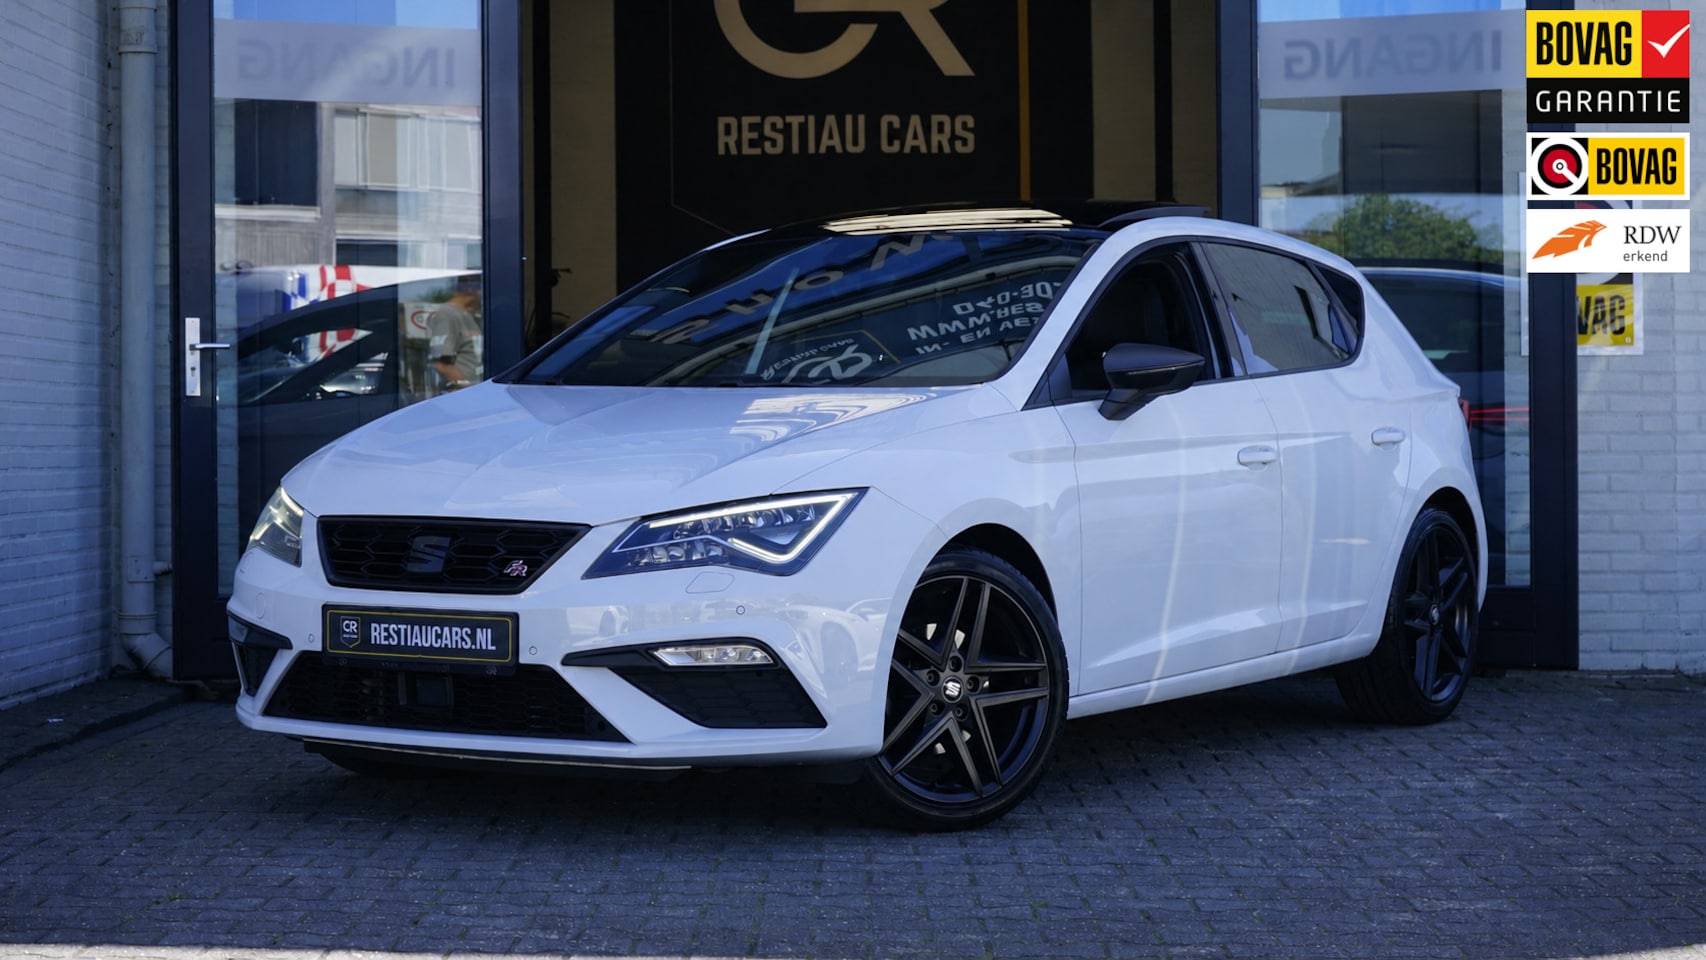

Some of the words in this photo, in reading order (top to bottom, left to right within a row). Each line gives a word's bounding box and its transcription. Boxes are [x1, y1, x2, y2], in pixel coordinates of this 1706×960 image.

[717, 114, 866, 155] RESTIAU
[879, 114, 976, 154] CARS
[1577, 295, 1626, 335] VAG
[342, 620, 358, 633] CR
[370, 622, 496, 651] RESTIAUCARS.NL
